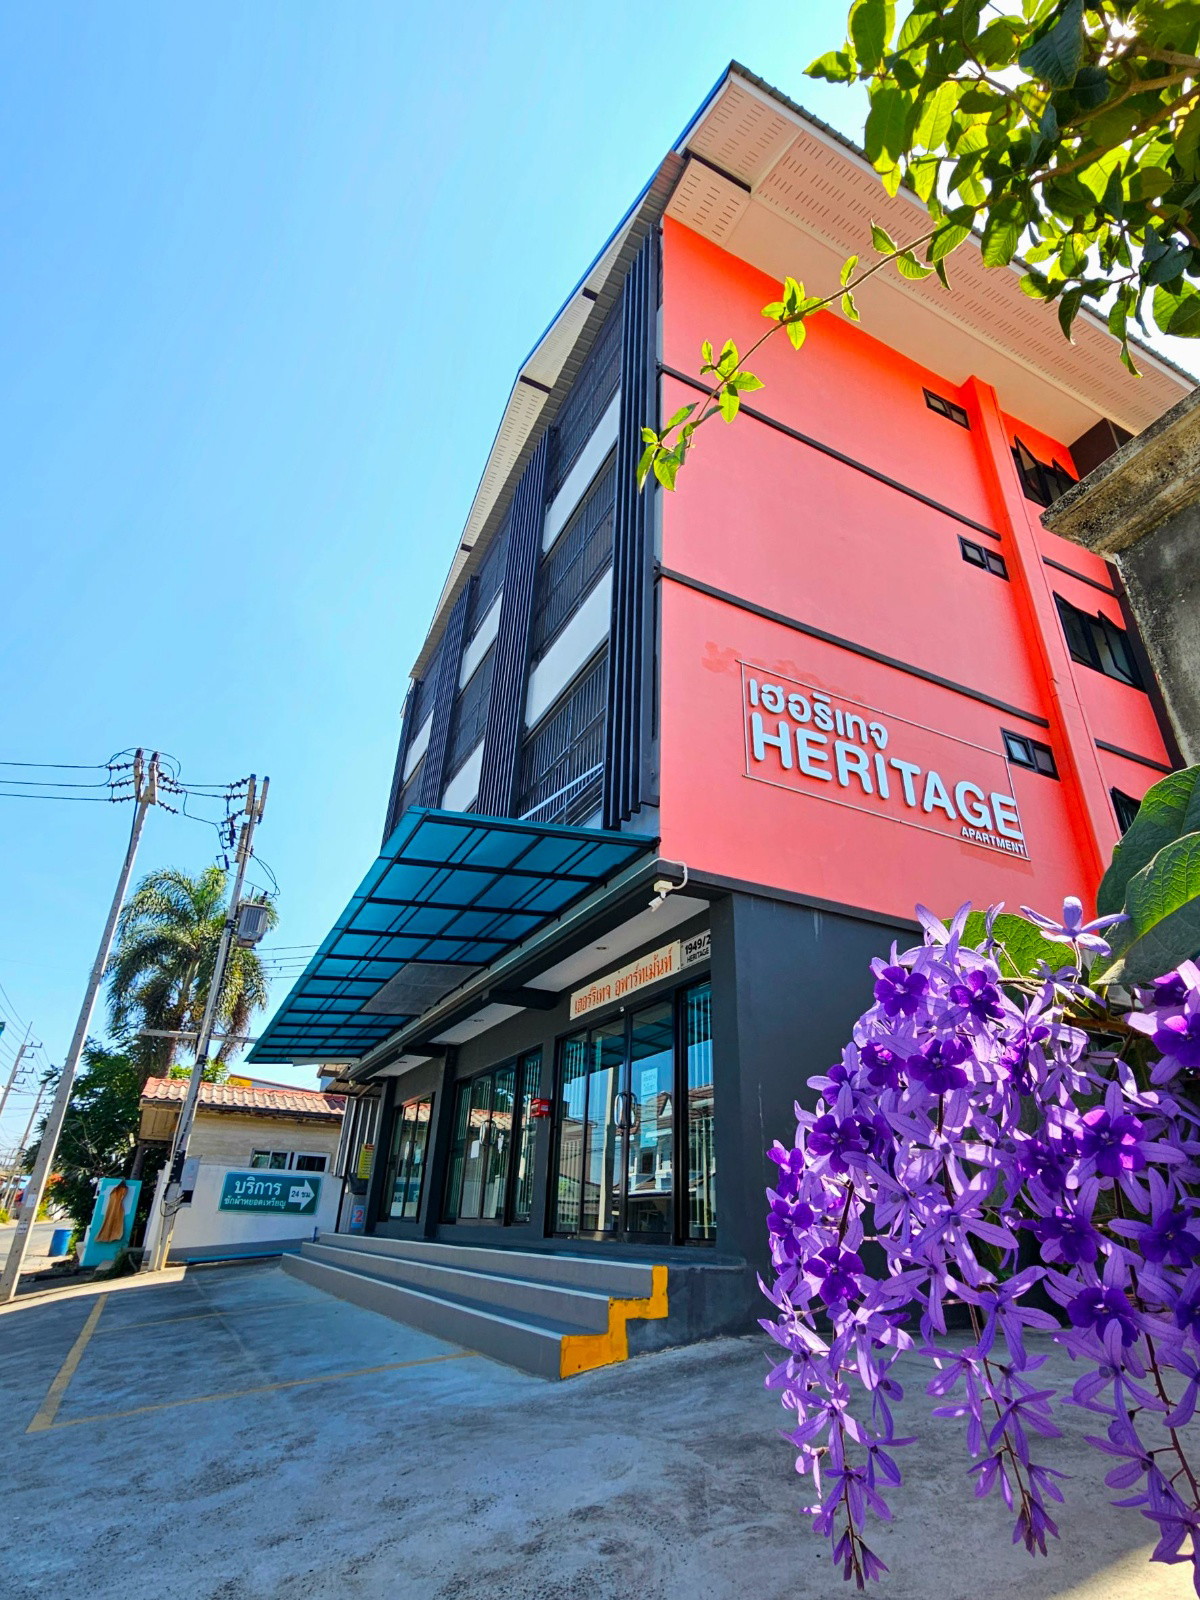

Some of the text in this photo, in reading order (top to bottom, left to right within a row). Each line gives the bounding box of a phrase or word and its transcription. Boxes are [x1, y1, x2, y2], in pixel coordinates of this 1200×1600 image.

[749, 678, 888, 749] เฮอริเทจ
[750, 711, 1023, 840] HERITAGE
[961, 826, 1025, 855] APARTMENT
[234, 1176, 282, 1196] บริการ
[291, 1190, 300, 1198] 24
